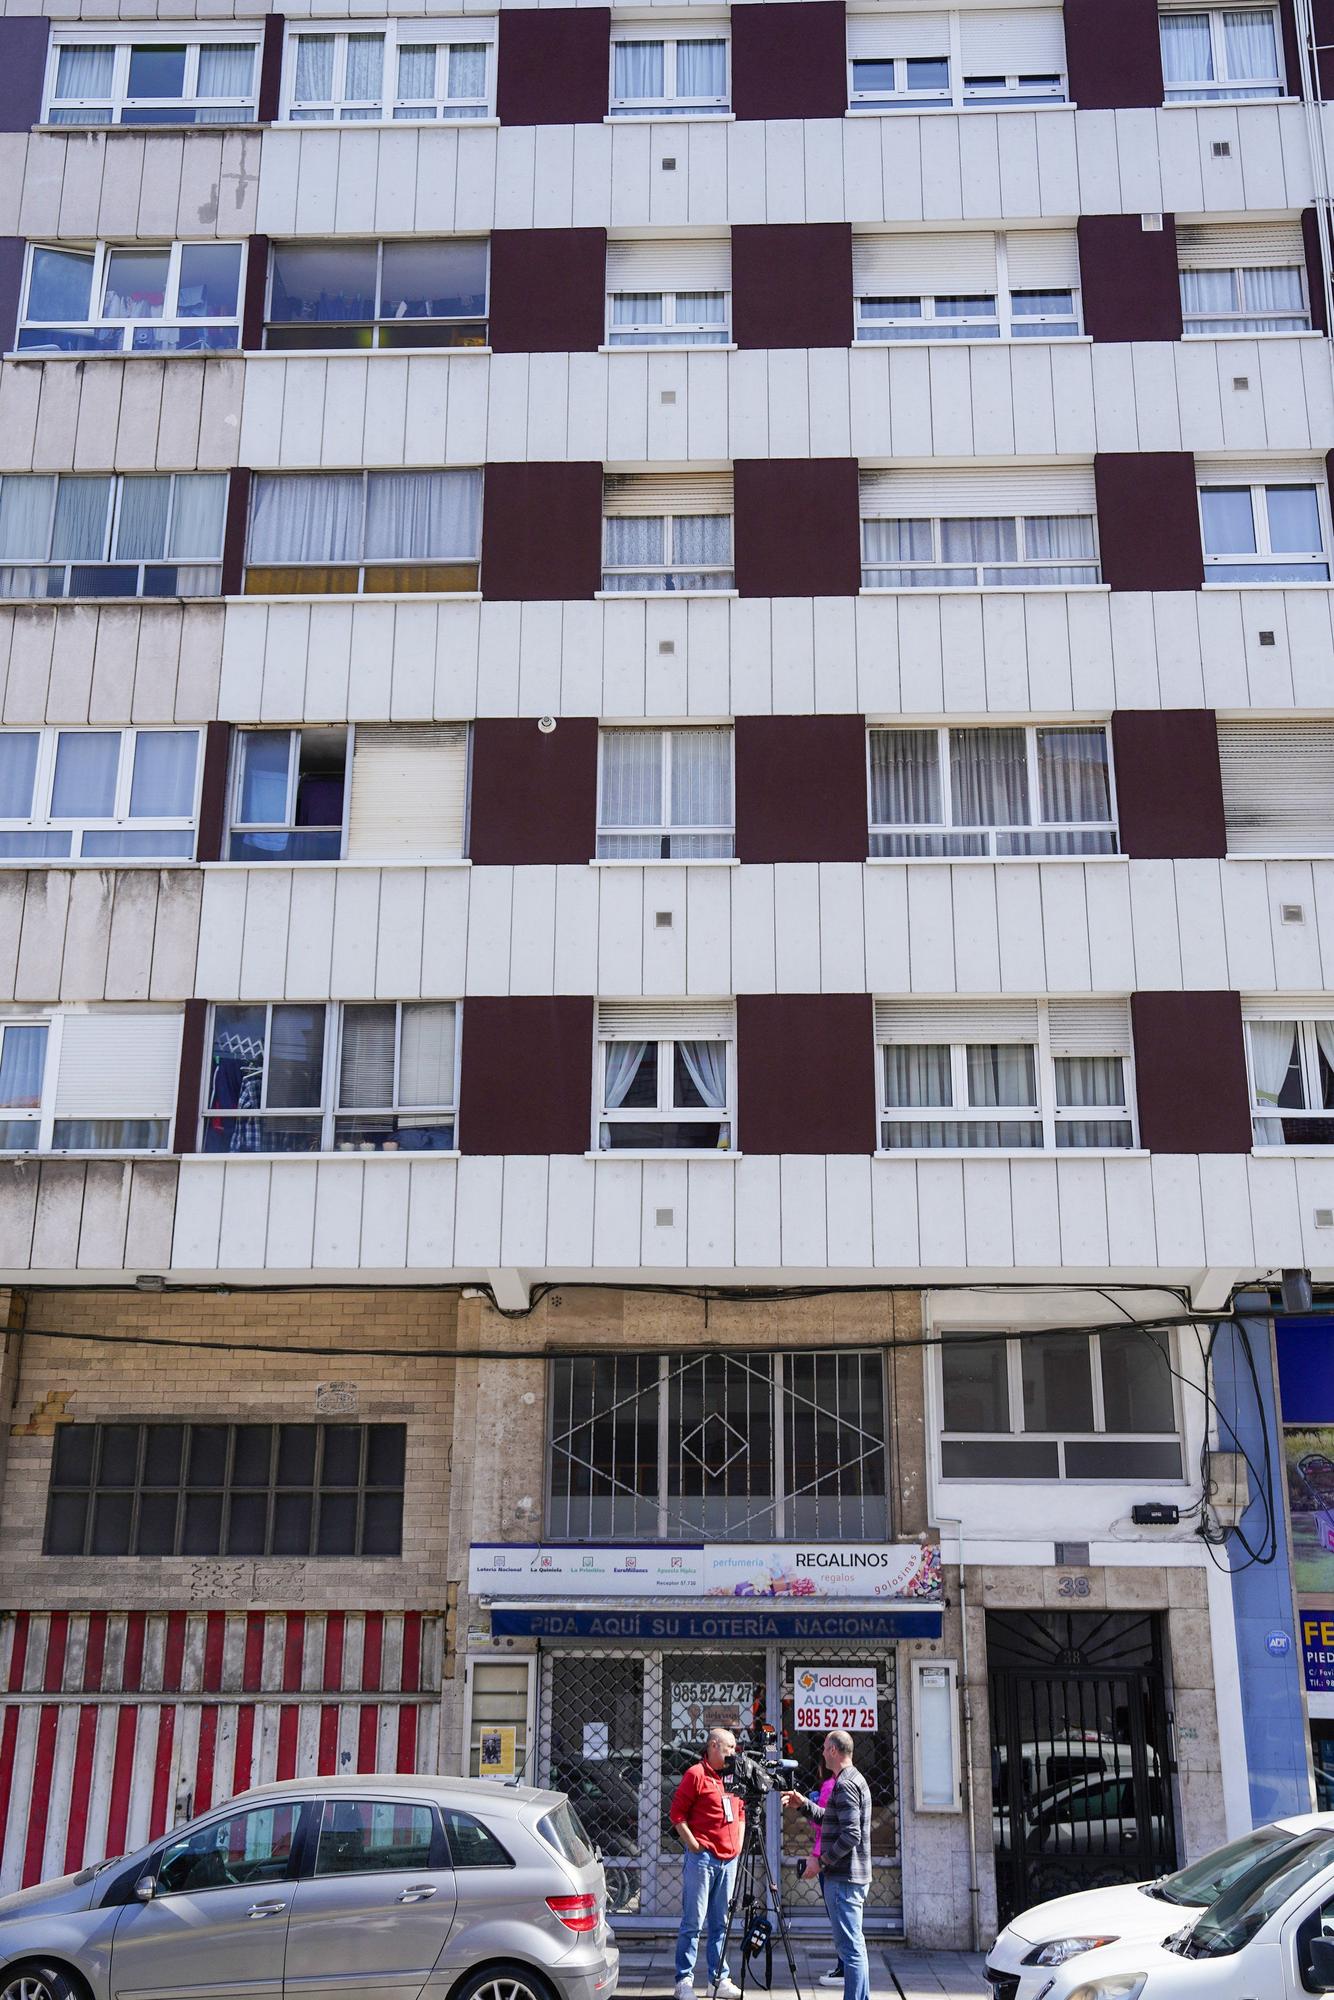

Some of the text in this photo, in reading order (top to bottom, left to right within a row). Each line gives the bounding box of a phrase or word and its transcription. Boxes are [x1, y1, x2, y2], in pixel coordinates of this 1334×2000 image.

[796, 1553, 888, 1567] REGALINOS
[821, 1573, 855, 1583] regalos
[874, 1554, 917, 1595] golosinas
[1058, 1576, 1090, 1597] 38
[530, 1614, 899, 1636] PIDA AQUÍ SU LOTERÍA NACIONAL
[1270, 1637, 1287, 1648] ADT
[819, 1674, 874, 1688] aldama
[804, 1695, 868, 1707] ALQUILA
[797, 1708, 875, 1728] 985 52 27 25
